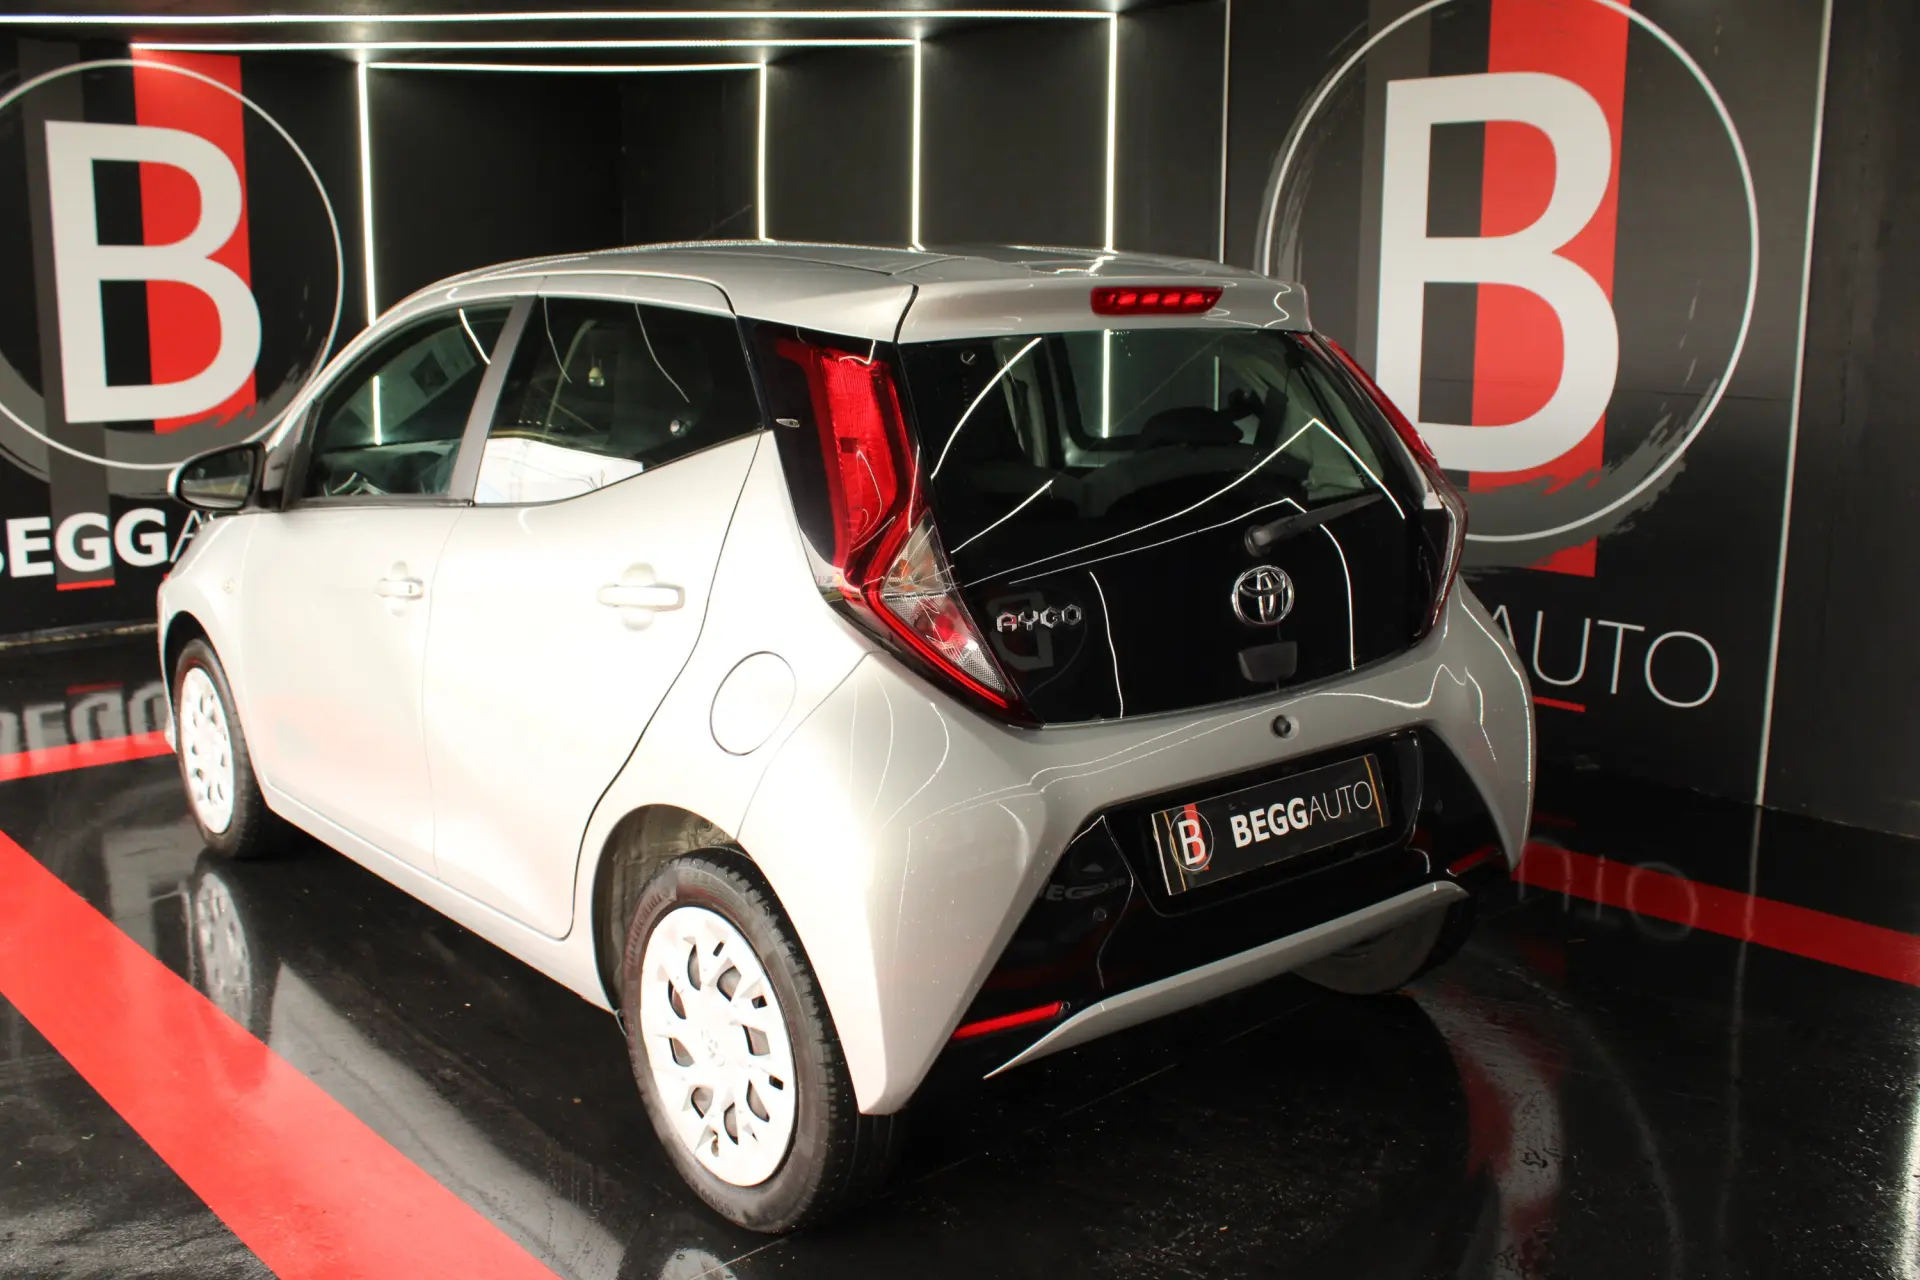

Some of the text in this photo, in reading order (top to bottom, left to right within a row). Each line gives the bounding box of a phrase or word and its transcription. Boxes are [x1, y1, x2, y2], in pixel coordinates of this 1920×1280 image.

[45, 120, 262, 423] B
[1375, 71, 1619, 474] B
[0, 507, 204, 578] EGGA
[996, 603, 1082, 632] AYGO
[1177, 781, 1373, 866] B BEGGAUTO
